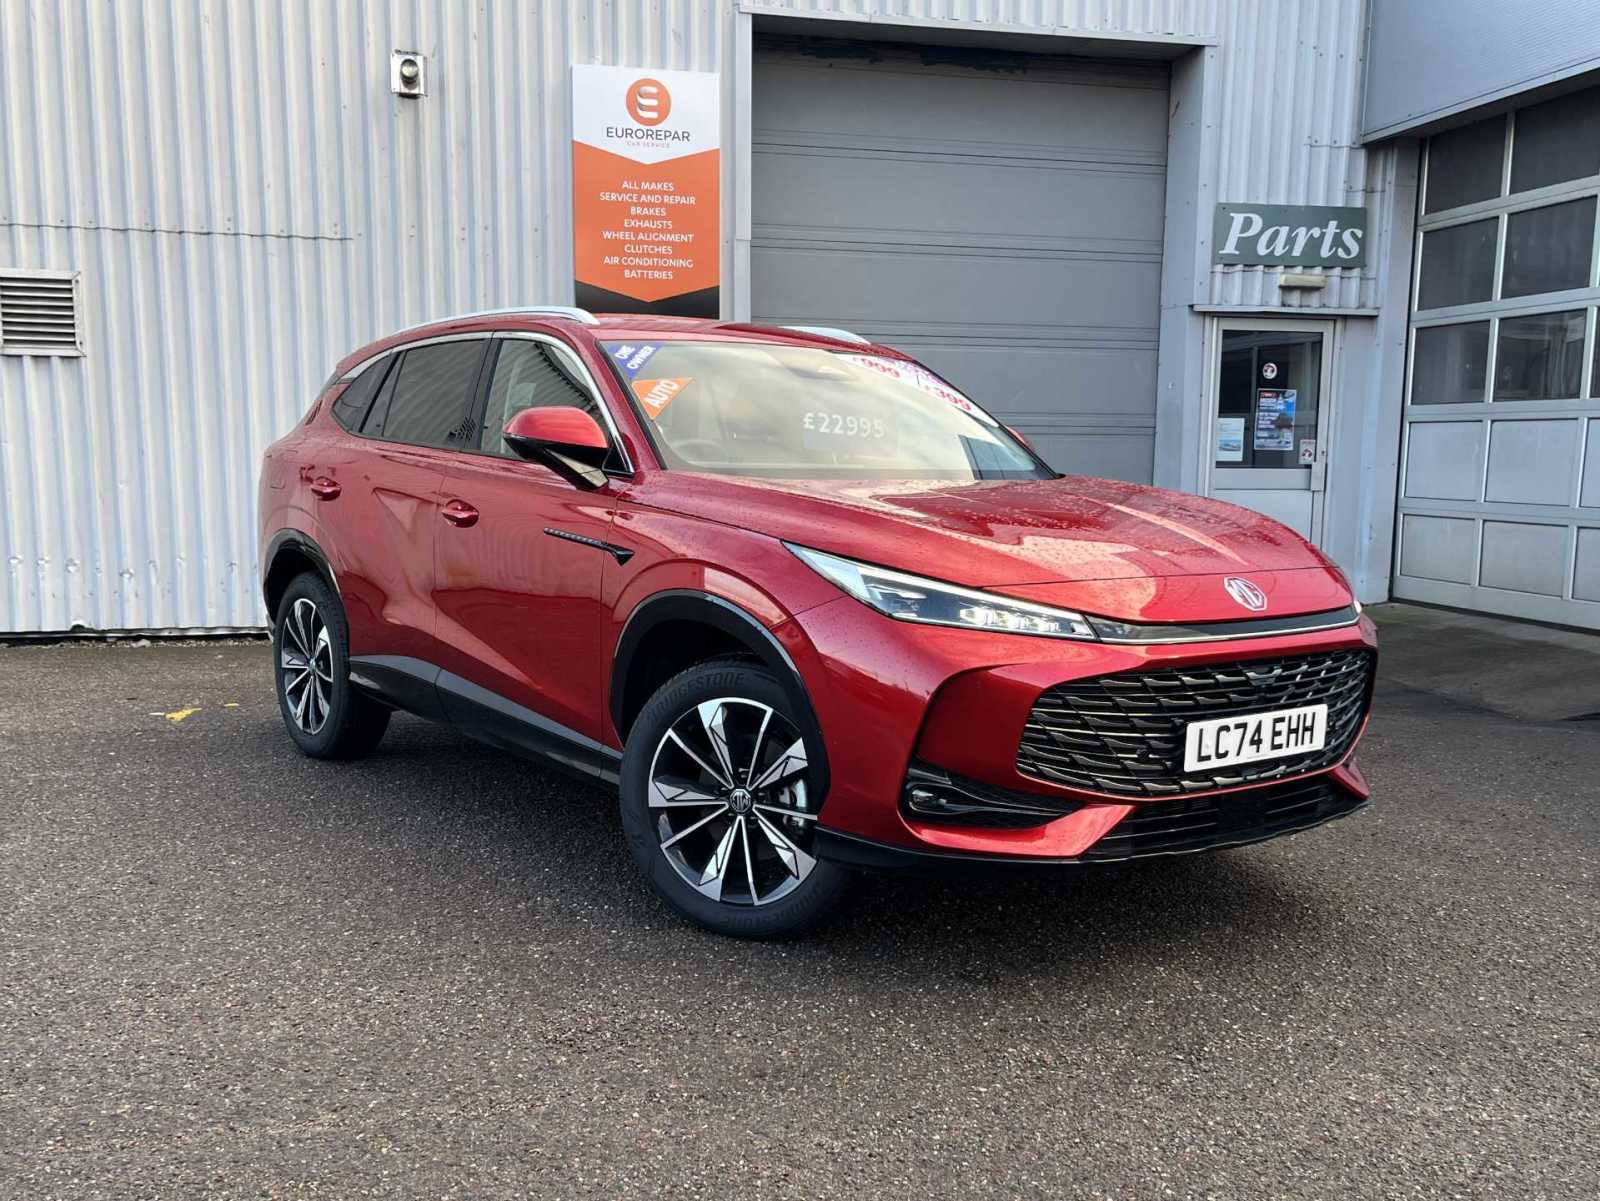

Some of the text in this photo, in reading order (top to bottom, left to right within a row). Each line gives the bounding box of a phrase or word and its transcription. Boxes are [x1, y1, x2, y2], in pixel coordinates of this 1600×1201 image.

[606, 126, 691, 142] EUROREPAR
[622, 181, 674, 191] ALL MAKES
[600, 192, 696, 205] SERVICE AND REPAIR
[630, 206, 666, 216] BRAKES
[624, 219, 673, 229] EXHAUSTS
[602, 231, 694, 242] WHEEL ALIGNMENT
[1218, 212, 1363, 259] Parts
[624, 244, 673, 255] CLUTCHES
[603, 256, 694, 268] AIR CONDITIONING
[624, 270, 673, 279] BATTERIES
[614, 345, 636, 359] ONE
[644, 379, 678, 408] AUTO
[803, 412, 885, 438] £22995
[1197, 711, 1317, 763] LC74 EHH
